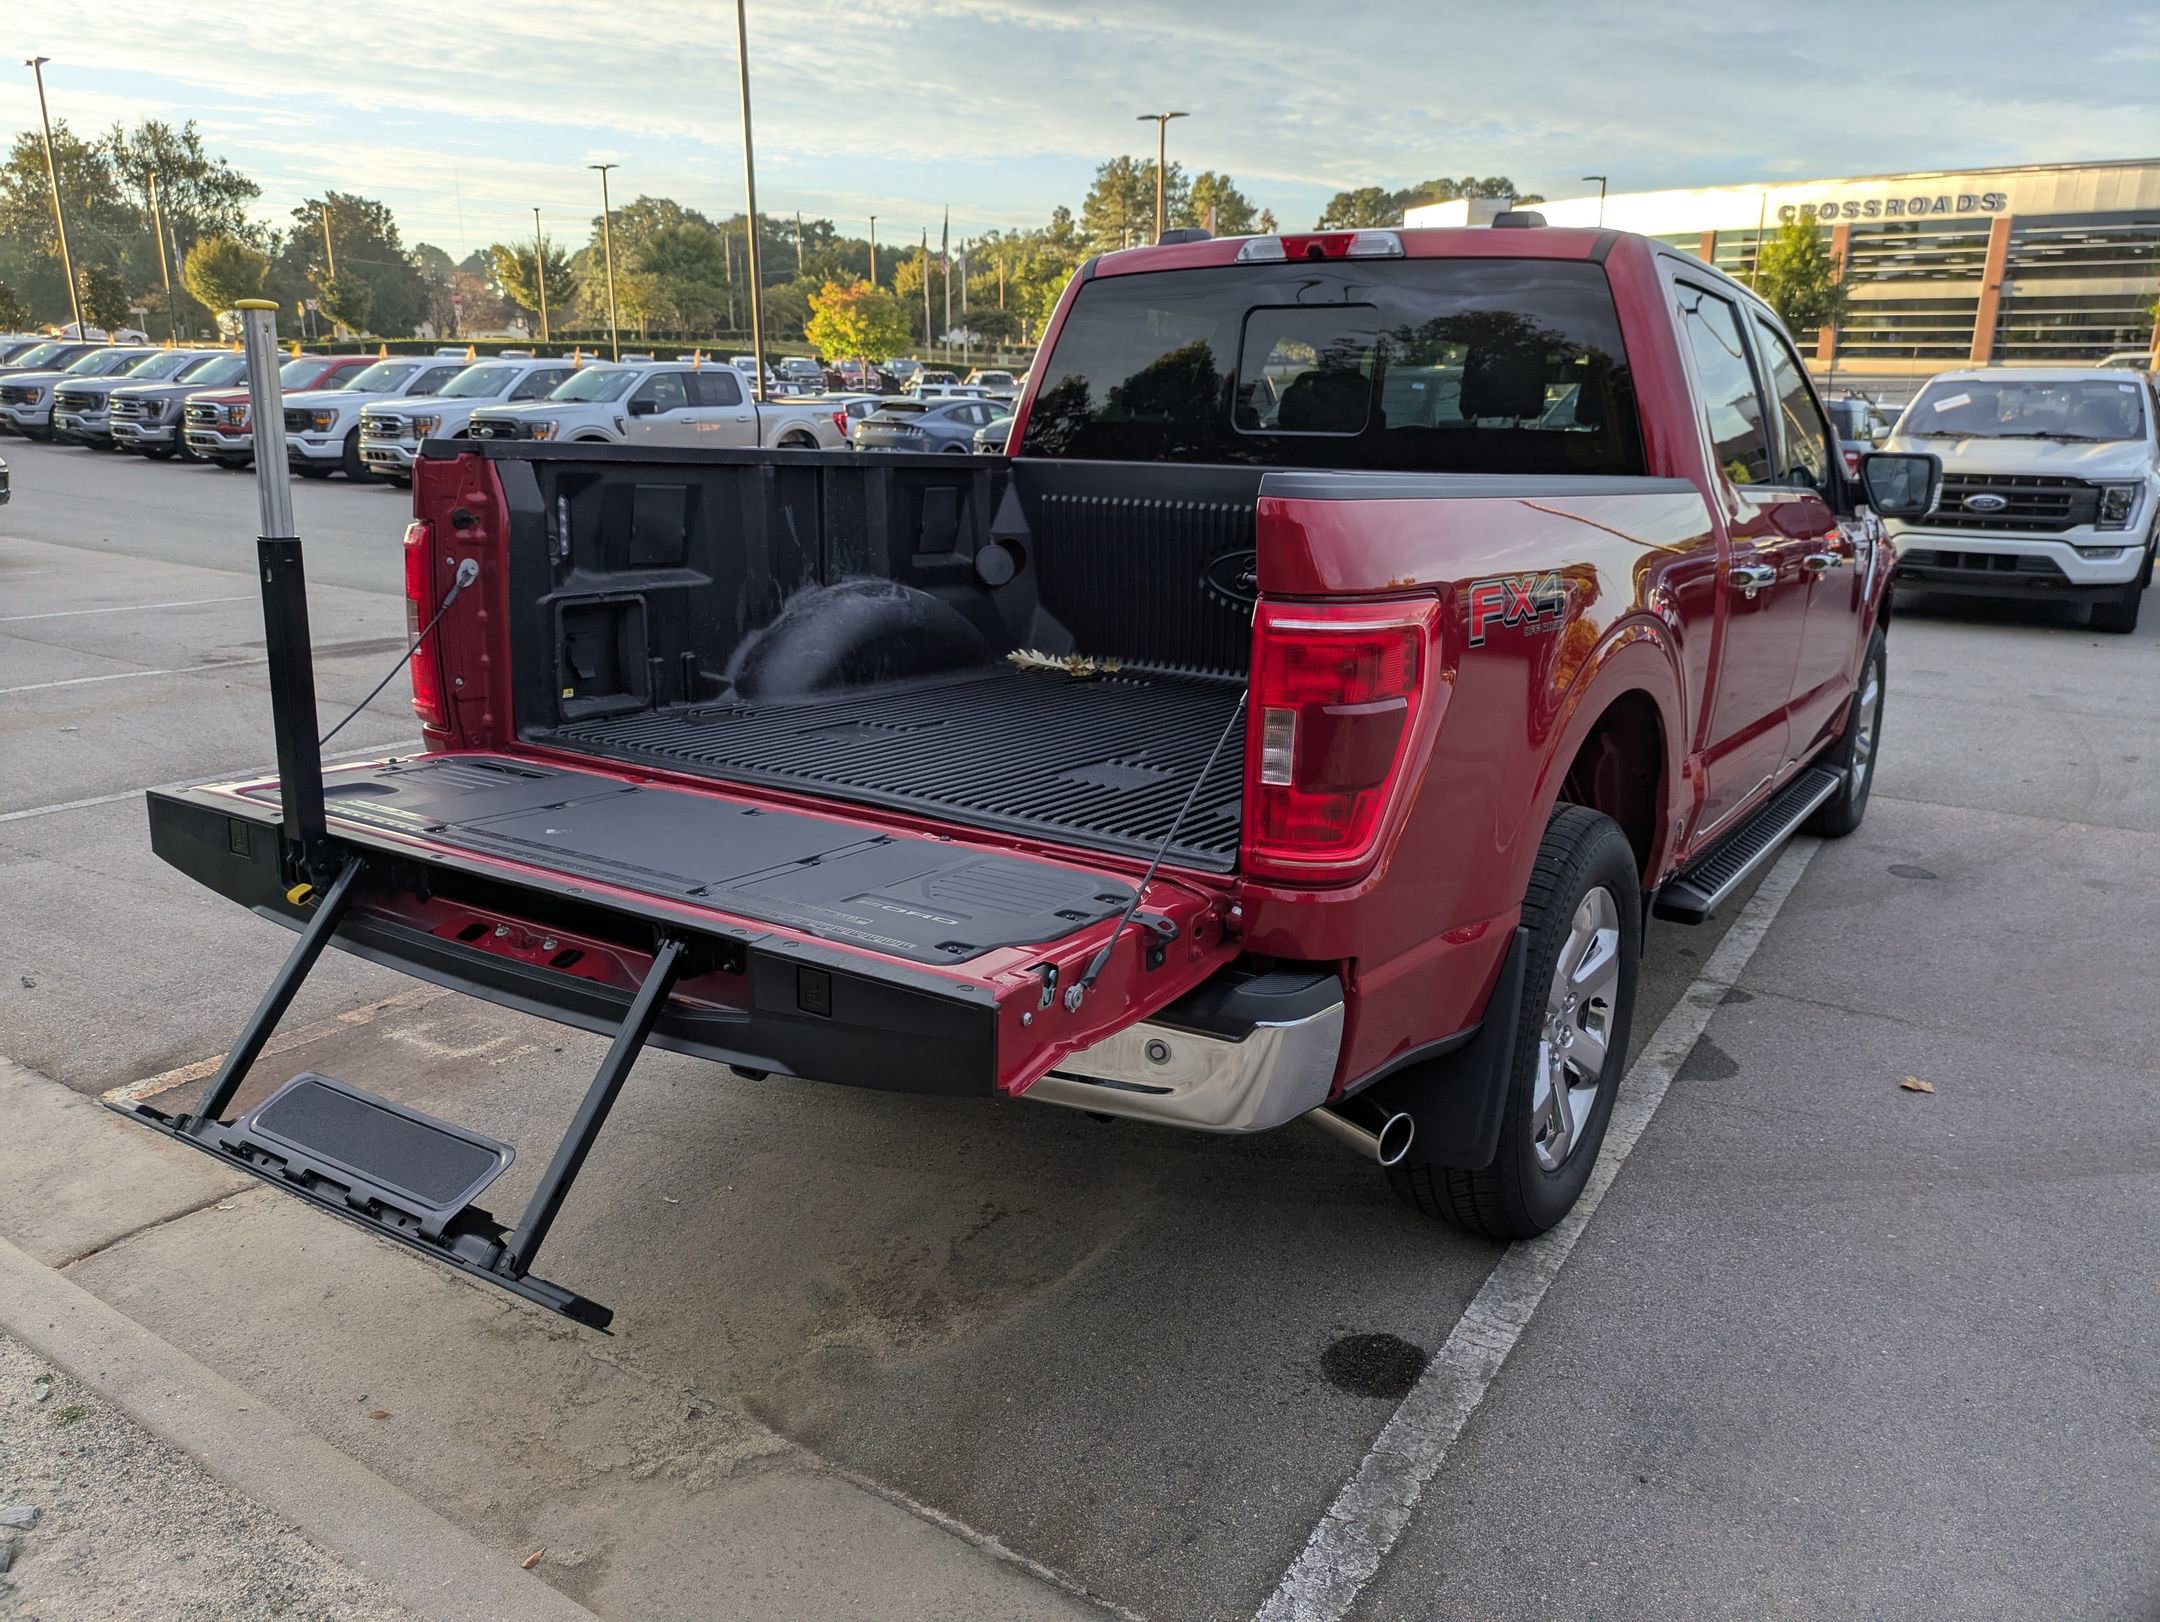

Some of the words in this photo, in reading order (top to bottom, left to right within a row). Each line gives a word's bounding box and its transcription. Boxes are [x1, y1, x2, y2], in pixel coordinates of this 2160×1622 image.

[1778, 193, 2007, 222] CROSSROADS
[1468, 569, 1565, 648] FX4
[856, 900, 959, 925] FORD
